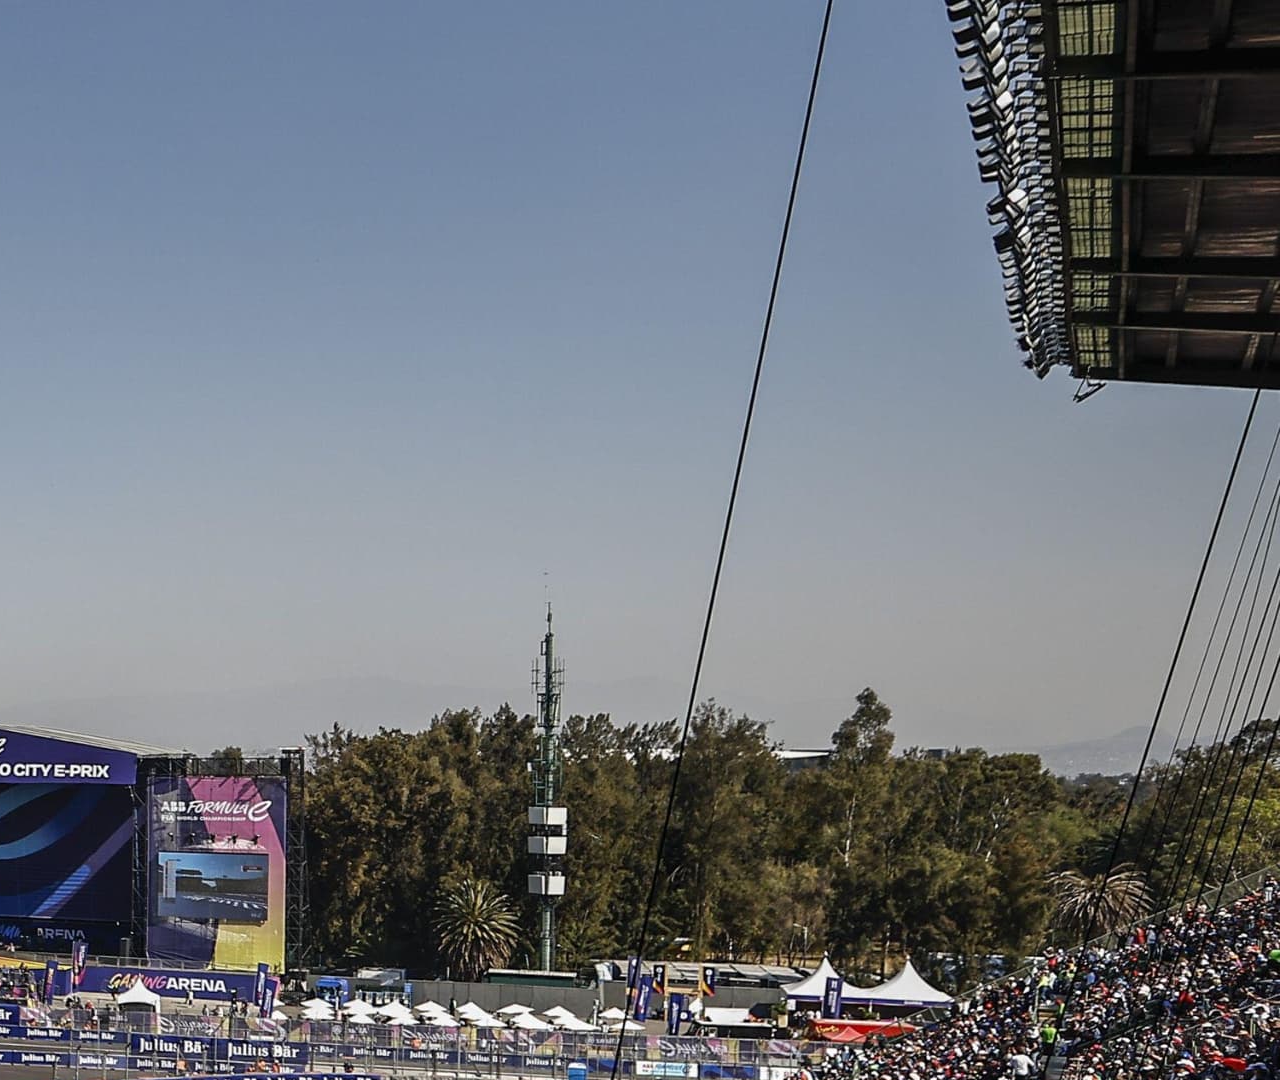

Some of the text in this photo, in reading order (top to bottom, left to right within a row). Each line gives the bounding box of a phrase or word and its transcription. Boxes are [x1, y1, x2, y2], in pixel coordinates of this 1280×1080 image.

[13, 764, 51, 777] CITY
[54, 764, 109, 778] E-PRIX
[161, 801, 186, 812] ABB
[186, 800, 249, 814] FORMULA
[227, 1040, 300, 1057] Julius Bär
